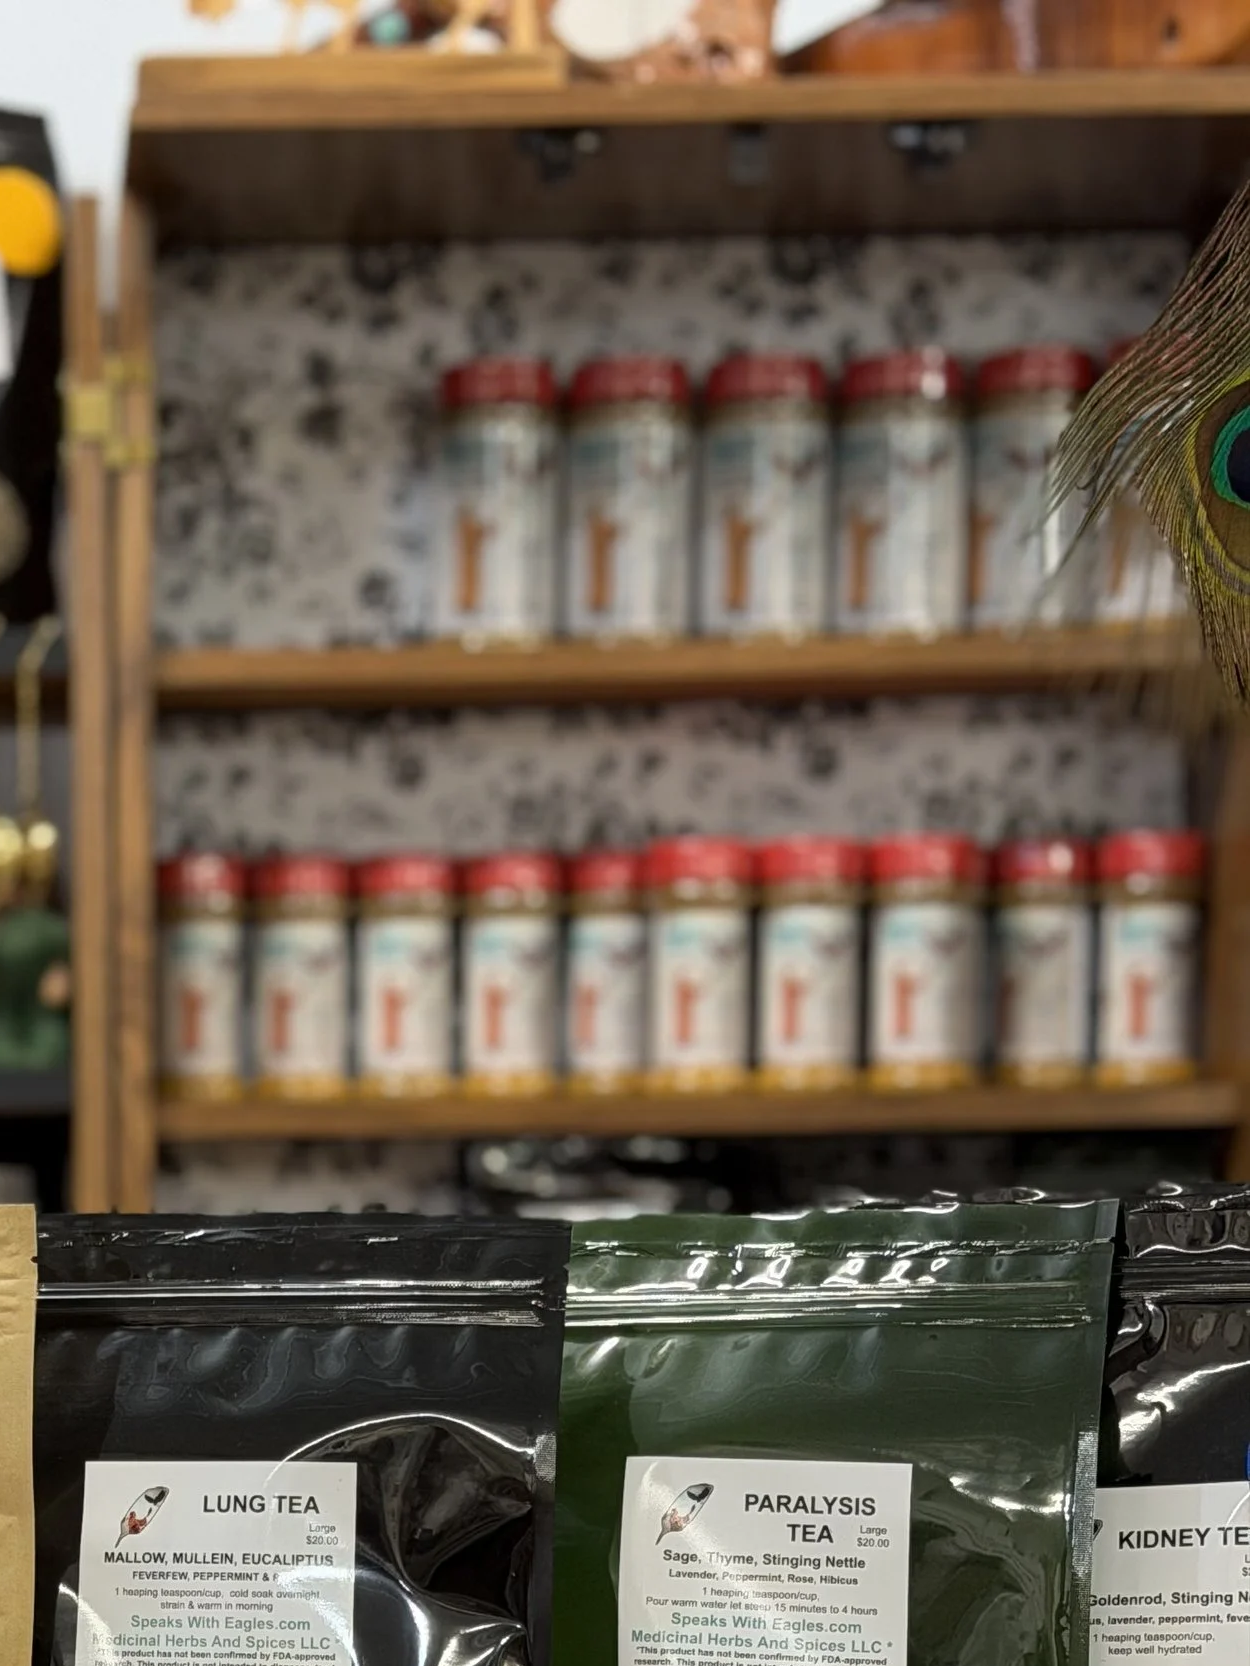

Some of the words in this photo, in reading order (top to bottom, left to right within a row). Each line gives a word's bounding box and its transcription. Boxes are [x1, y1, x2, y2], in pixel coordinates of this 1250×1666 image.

[203, 1496, 266, 1513] LUNG
[274, 1496, 320, 1514] TEA
[744, 1494, 876, 1516] PARALYSIS
[309, 1523, 336, 1533] Large
[787, 1524, 833, 1543] TEA
[860, 1526, 887, 1536] Large
[306, 1535, 339, 1546] $20.00
[857, 1537, 889, 1548] $20.00
[1118, 1528, 1209, 1550] KIDNEY
[1217, 1526, 1250, 1546] TE
[104, 1552, 167, 1565] MALLOW,
[173, 1553, 236, 1565] MULLEIN,
[242, 1554, 333, 1566] EUCALIPTUS
[663, 1550, 701, 1565] Sage,
[706, 1551, 757, 1566] Thyme,
[762, 1553, 821, 1569] Stinging
[826, 1555, 865, 1569] Nettle
[1089, 1592, 1166, 1607] Goldenrod,
[1171, 1591, 1233, 1606] Stinging
[671, 1612, 726, 1628] Speaks
[732, 1614, 766, 1630] With
[772, 1618, 862, 1635] Eagles.com
